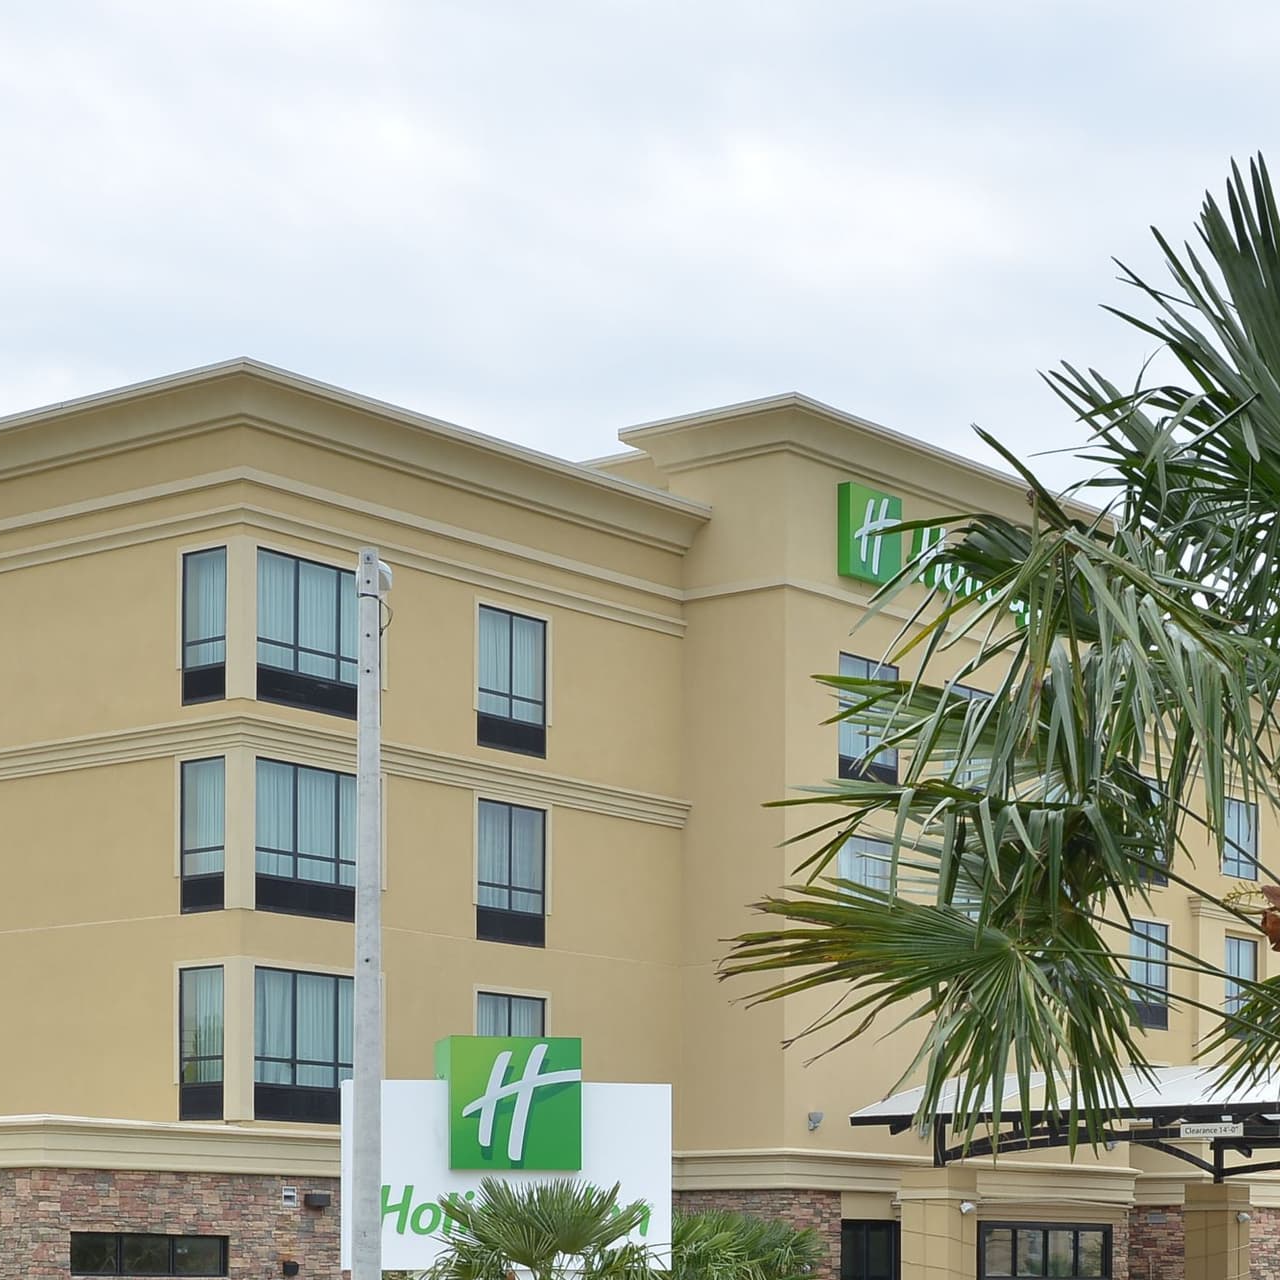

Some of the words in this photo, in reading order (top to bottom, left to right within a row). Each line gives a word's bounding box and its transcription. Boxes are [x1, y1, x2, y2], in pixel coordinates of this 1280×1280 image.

[854, 498, 902, 576] H
[462, 1043, 582, 1162] H
[1184, 1127, 1218, 1135] Clearance
